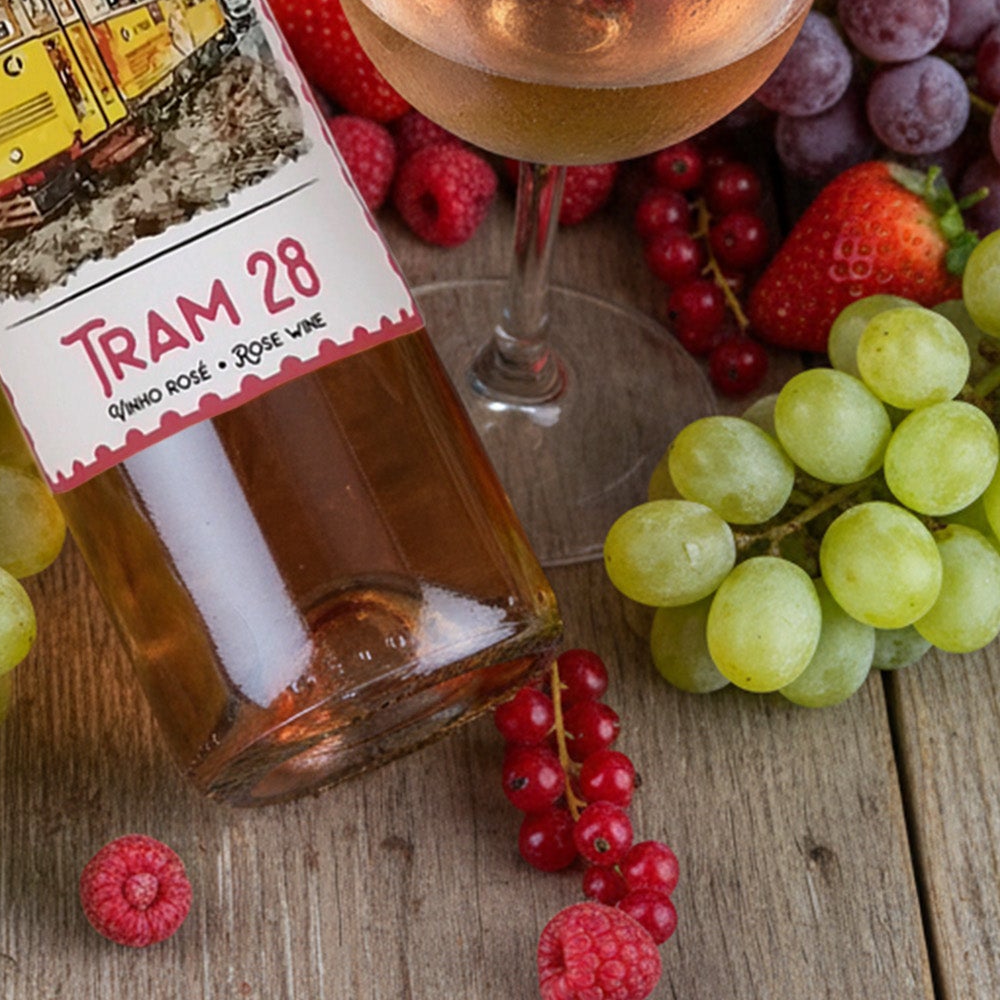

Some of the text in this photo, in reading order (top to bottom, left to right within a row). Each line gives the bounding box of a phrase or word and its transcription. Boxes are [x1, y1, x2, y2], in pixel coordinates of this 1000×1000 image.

[61, 237, 321, 398] TRAM 28
[107, 312, 327, 421] VINHO ROSÉ ROSE WINE
